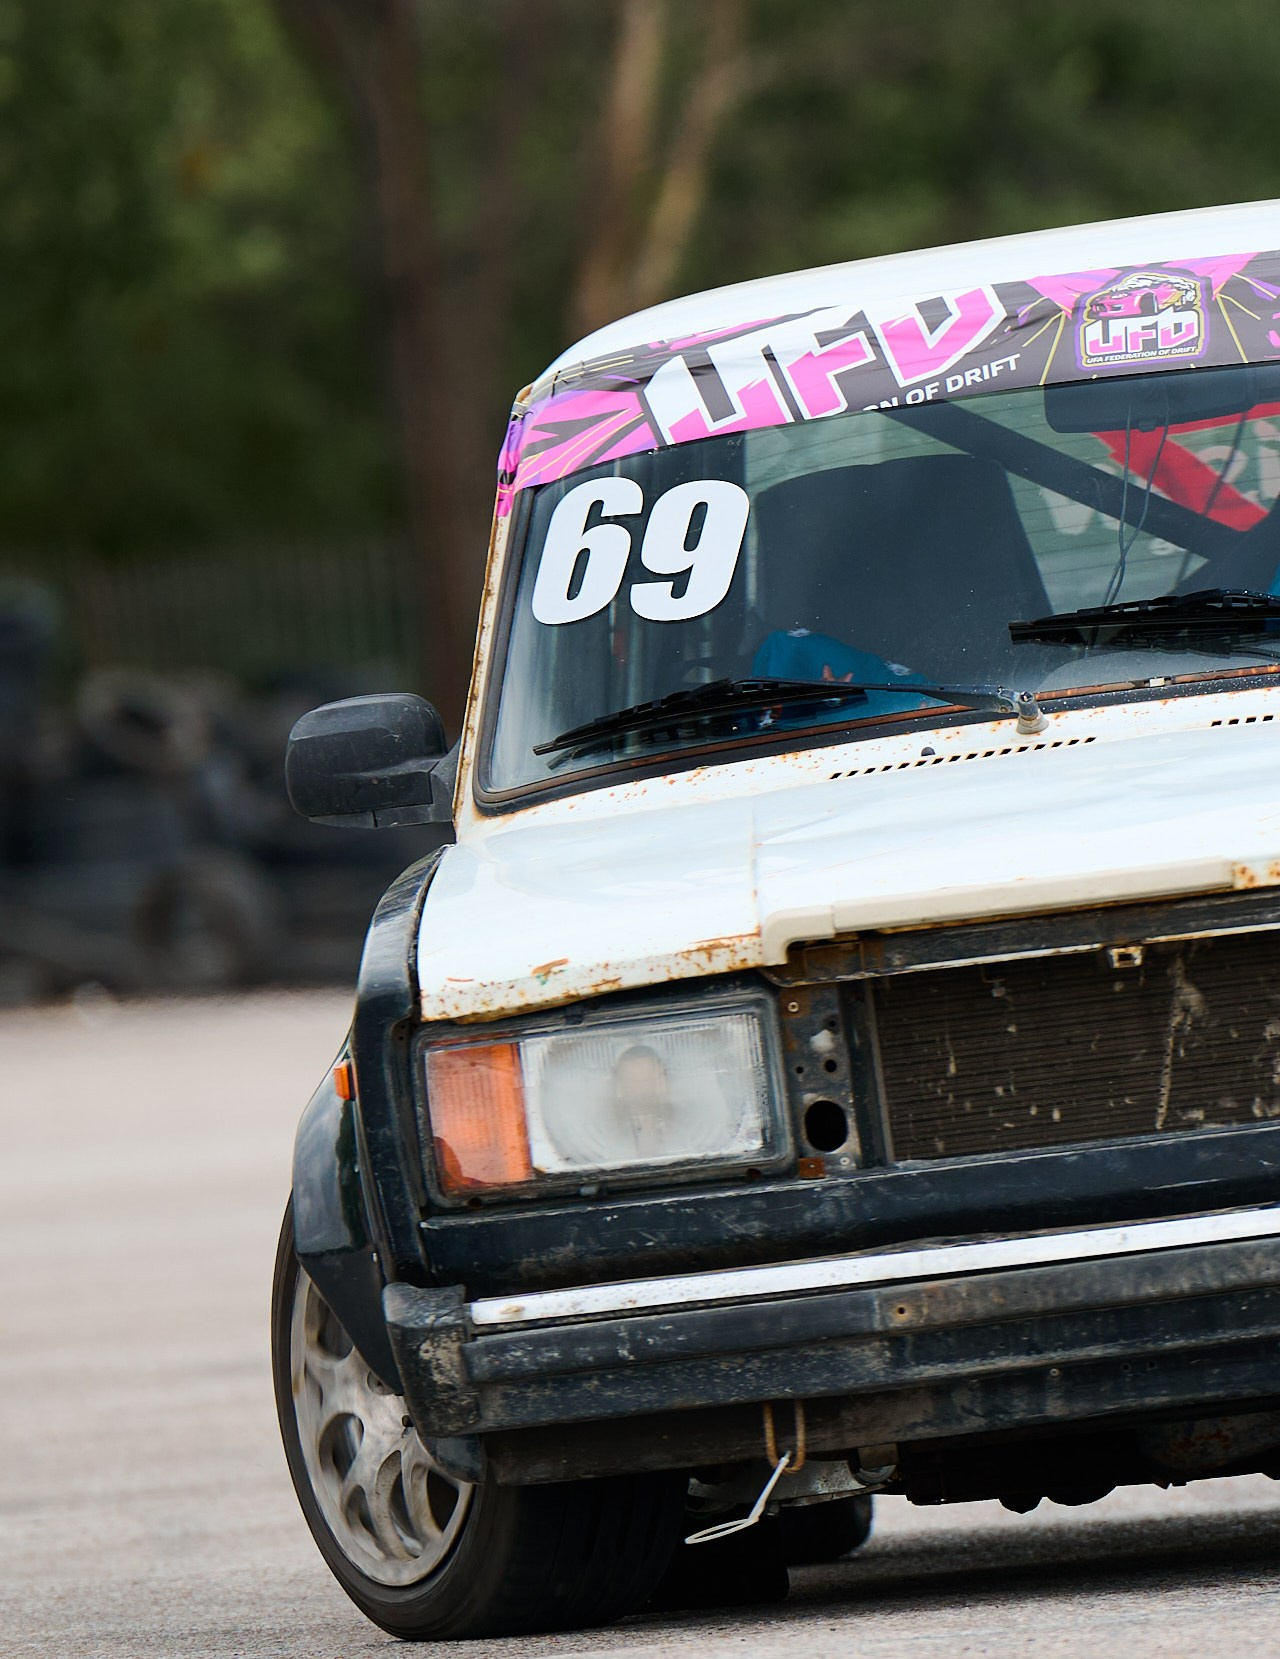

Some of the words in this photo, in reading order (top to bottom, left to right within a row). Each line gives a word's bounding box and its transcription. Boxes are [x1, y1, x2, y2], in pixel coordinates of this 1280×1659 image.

[1085, 306, 1199, 356] UFD
[1104, 350, 1157, 362] FEDERATION
[1158, 348, 1171, 356] OF
[1171, 346, 1197, 354] DRIFT
[905, 381, 940, 405] OF
[945, 353, 1021, 393] DRIFT
[531, 476, 750, 625] 69
